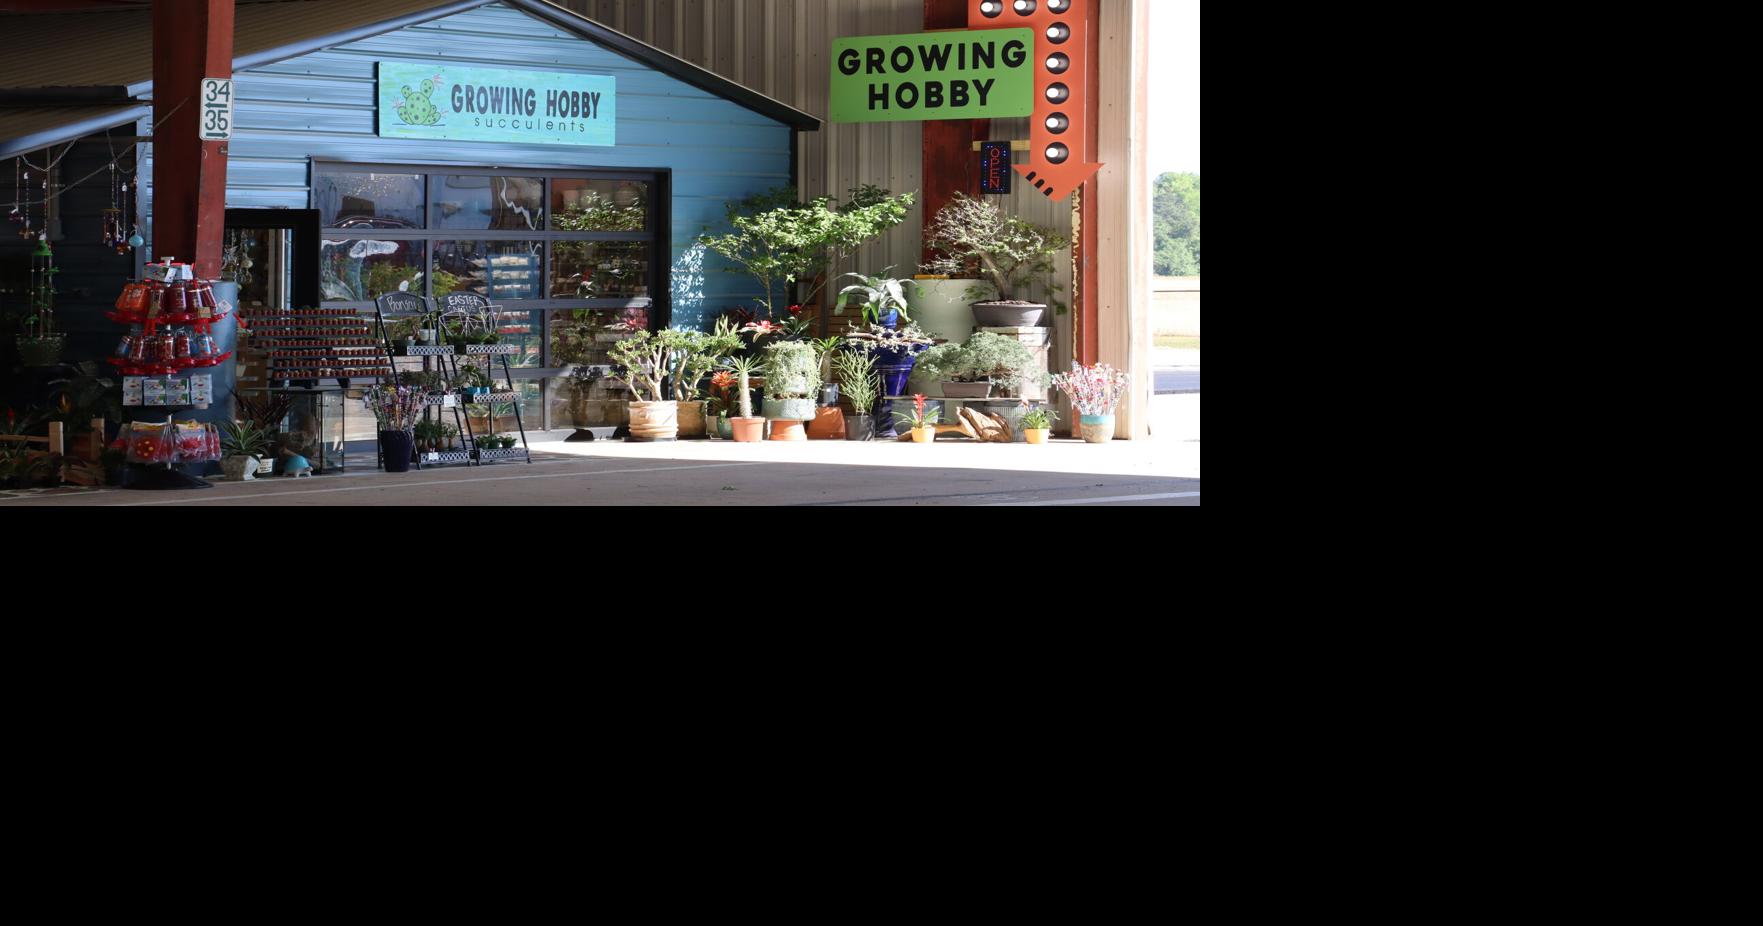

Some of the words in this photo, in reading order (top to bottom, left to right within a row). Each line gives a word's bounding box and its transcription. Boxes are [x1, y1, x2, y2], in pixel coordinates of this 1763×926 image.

[838, 40, 1026, 75] GROWING
[206, 81, 230, 102] 34
[451, 84, 536, 117] GROWING
[546, 89, 601, 119] HOBBY
[868, 79, 995, 110] HOBBY
[205, 110, 229, 131] 35
[474, 116, 585, 133] succulents
[990, 148, 1000, 189] OPEN
[447, 295, 483, 306] EASTER
